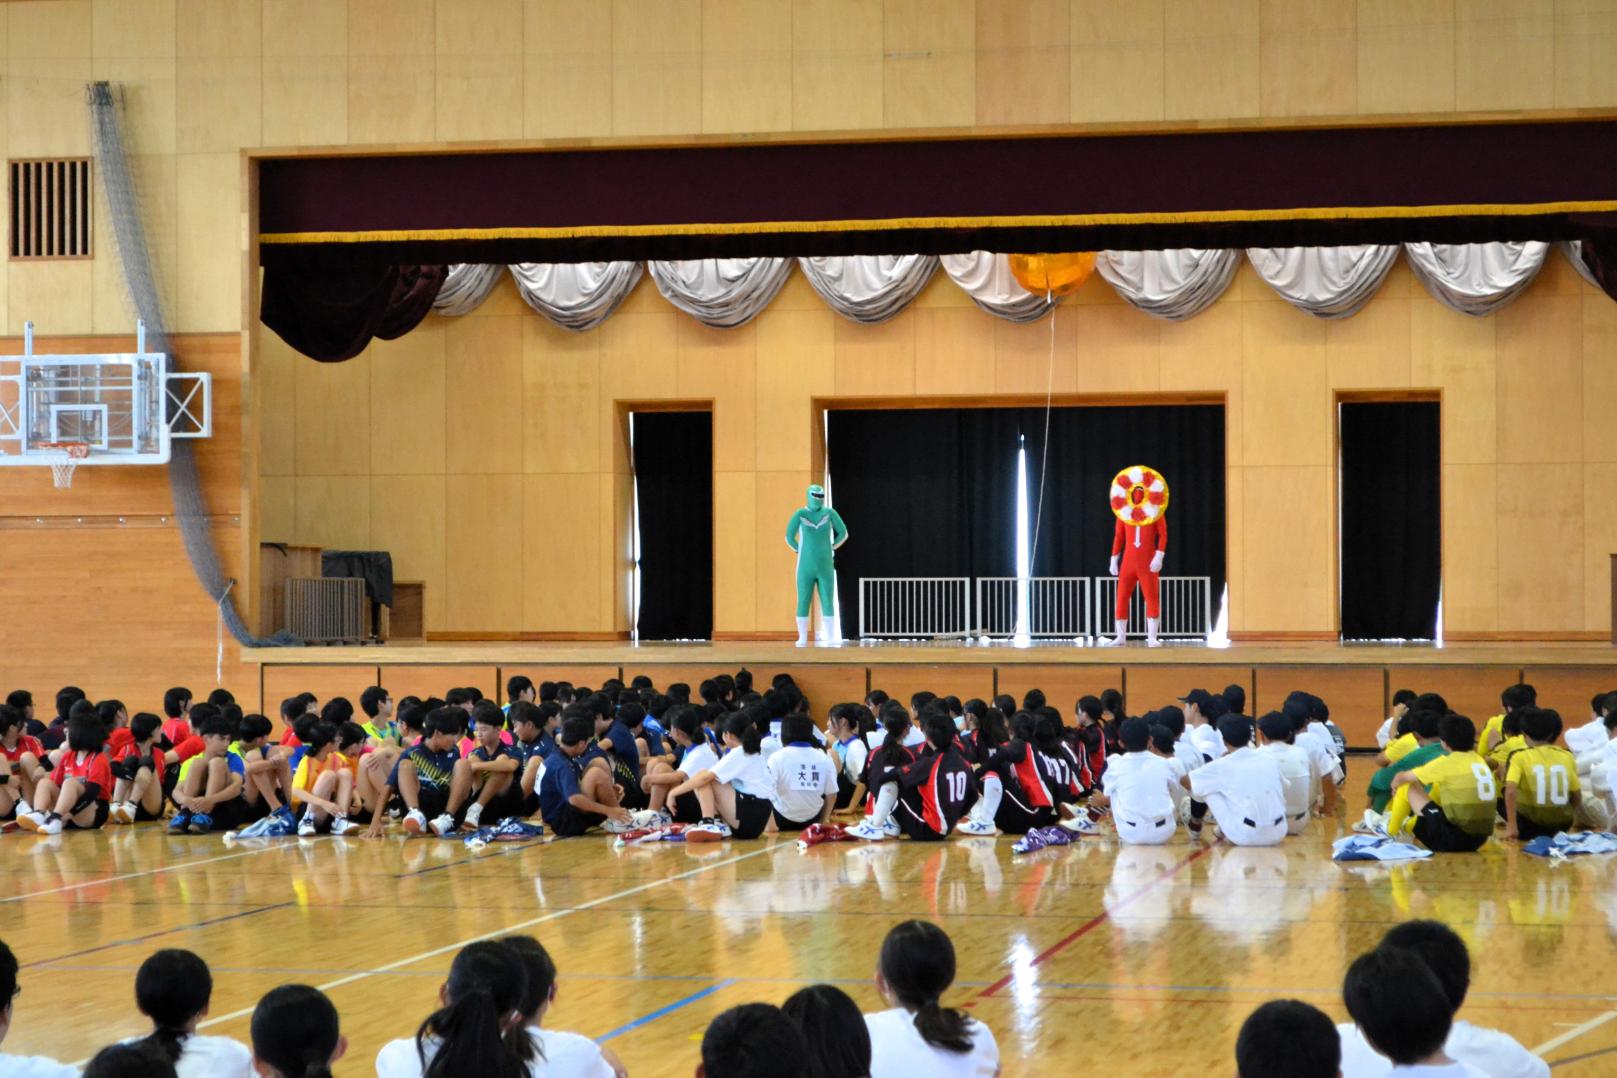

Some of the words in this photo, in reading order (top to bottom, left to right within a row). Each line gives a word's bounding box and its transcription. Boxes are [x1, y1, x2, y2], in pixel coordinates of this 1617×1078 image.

[946, 770, 967, 803] 10
[1471, 763, 1495, 801] 8
[1532, 764, 1568, 805] 10
